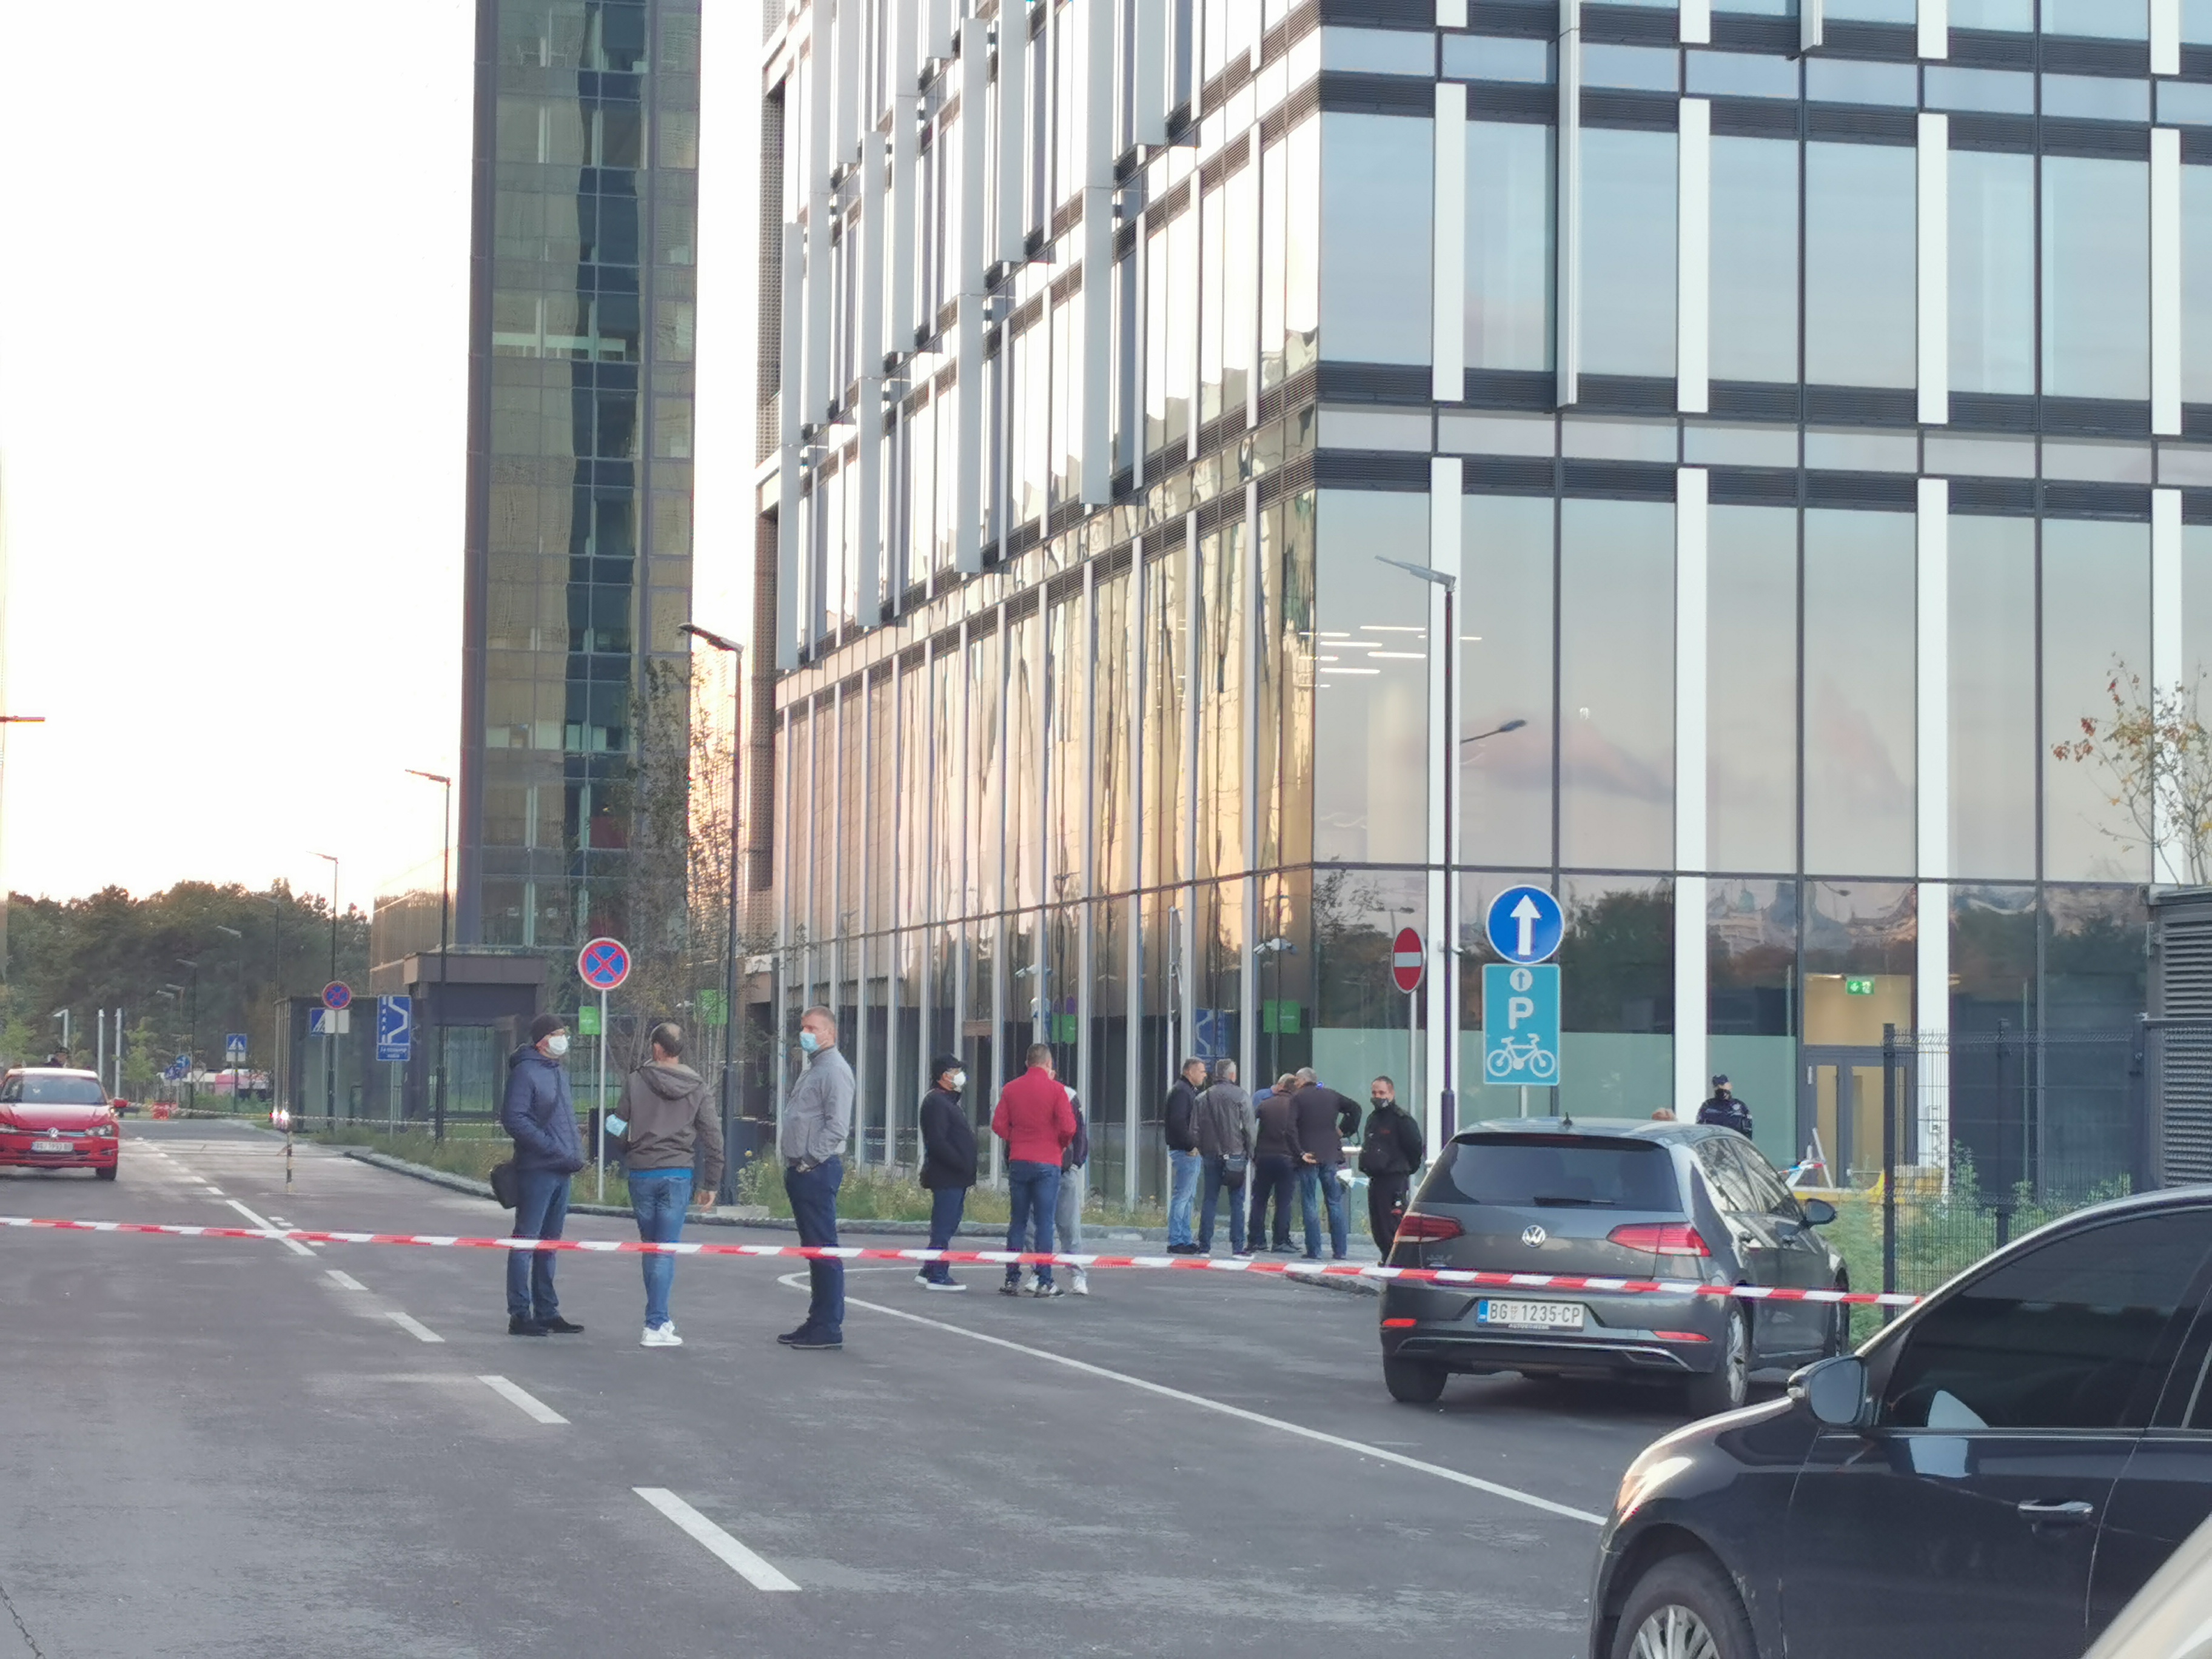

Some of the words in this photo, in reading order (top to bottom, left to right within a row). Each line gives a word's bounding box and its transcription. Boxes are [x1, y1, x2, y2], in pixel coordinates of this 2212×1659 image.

[1509, 997, 1533, 1030] P
[1490, 1304, 1508, 1319] BG
[1521, 1304, 1580, 1324] 1235-CP
